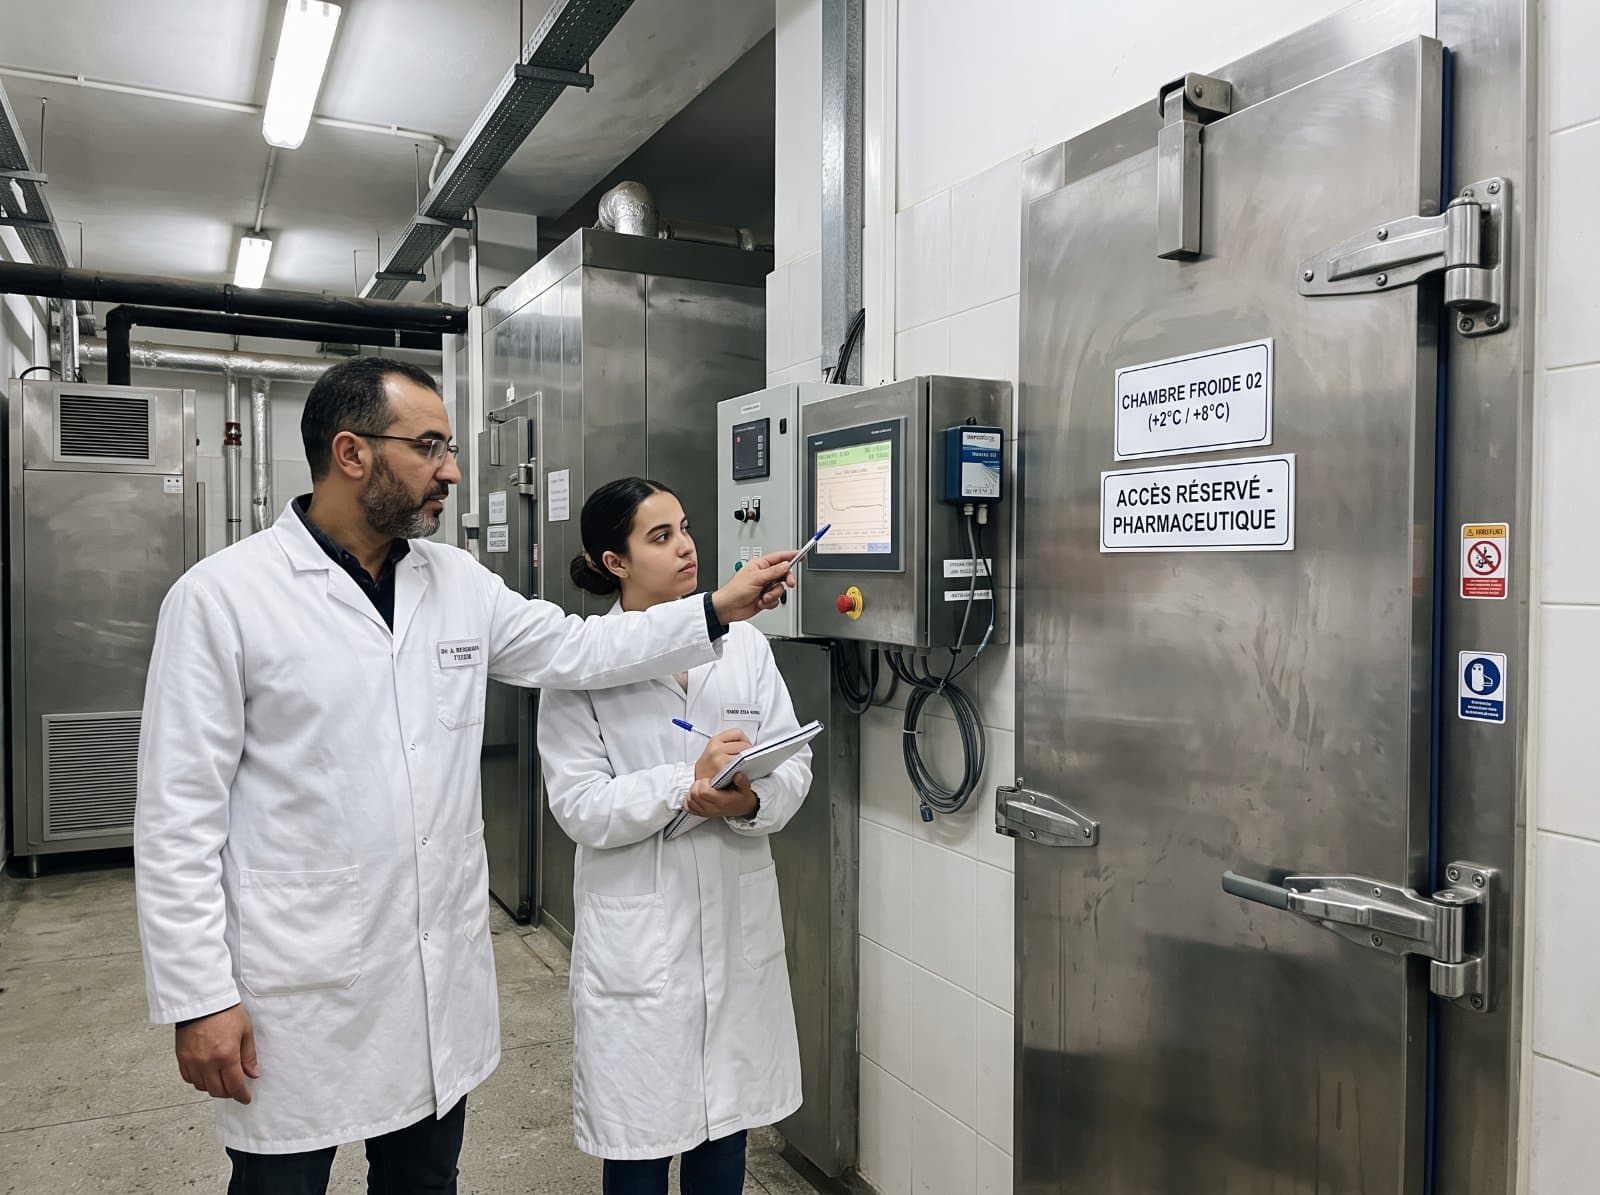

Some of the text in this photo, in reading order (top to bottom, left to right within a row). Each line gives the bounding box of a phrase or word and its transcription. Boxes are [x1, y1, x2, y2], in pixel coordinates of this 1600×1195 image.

[1122, 372, 1262, 410] CHAMBRE FROIDE 02
[1148, 401, 1230, 432] (+2°C / +8°C)
[1116, 482, 1171, 507] ACCÈS
[1176, 474, 1261, 504] RÉSERVÉ
[1113, 508, 1276, 535] PHARMACEUTIQUE
